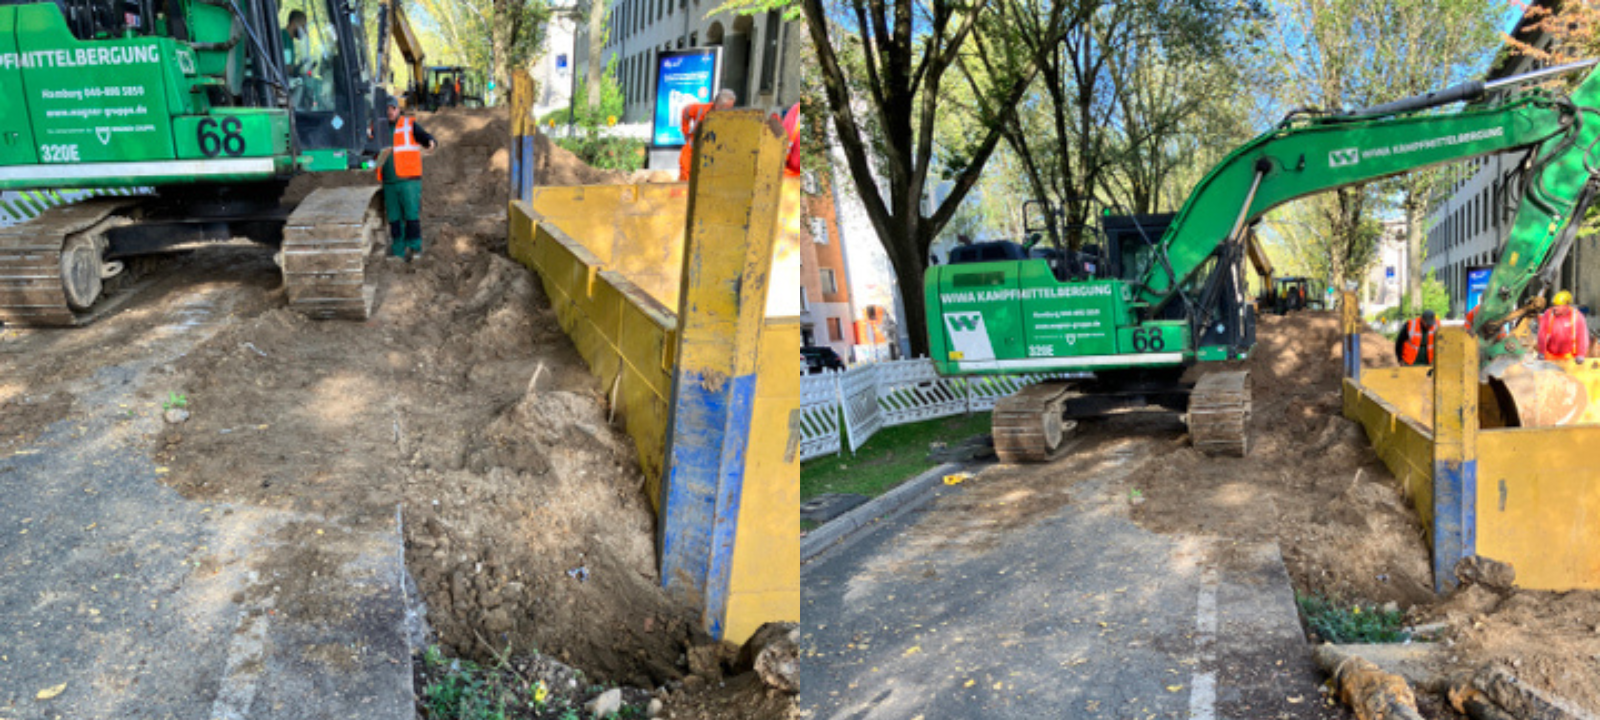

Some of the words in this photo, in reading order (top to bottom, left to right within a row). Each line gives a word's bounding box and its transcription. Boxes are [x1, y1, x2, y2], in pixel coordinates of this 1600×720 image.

[41, 88, 83, 101] Hamburg
[196, 115, 246, 158] 68
[1393, 126, 1504, 154] KAMPFMITTELBERGUNG
[41, 144, 81, 163] 320E
[940, 290, 976, 304] WIWA
[977, 284, 1112, 303] KAMPFMITTELBERGUNG
[1132, 326, 1165, 352] 68
